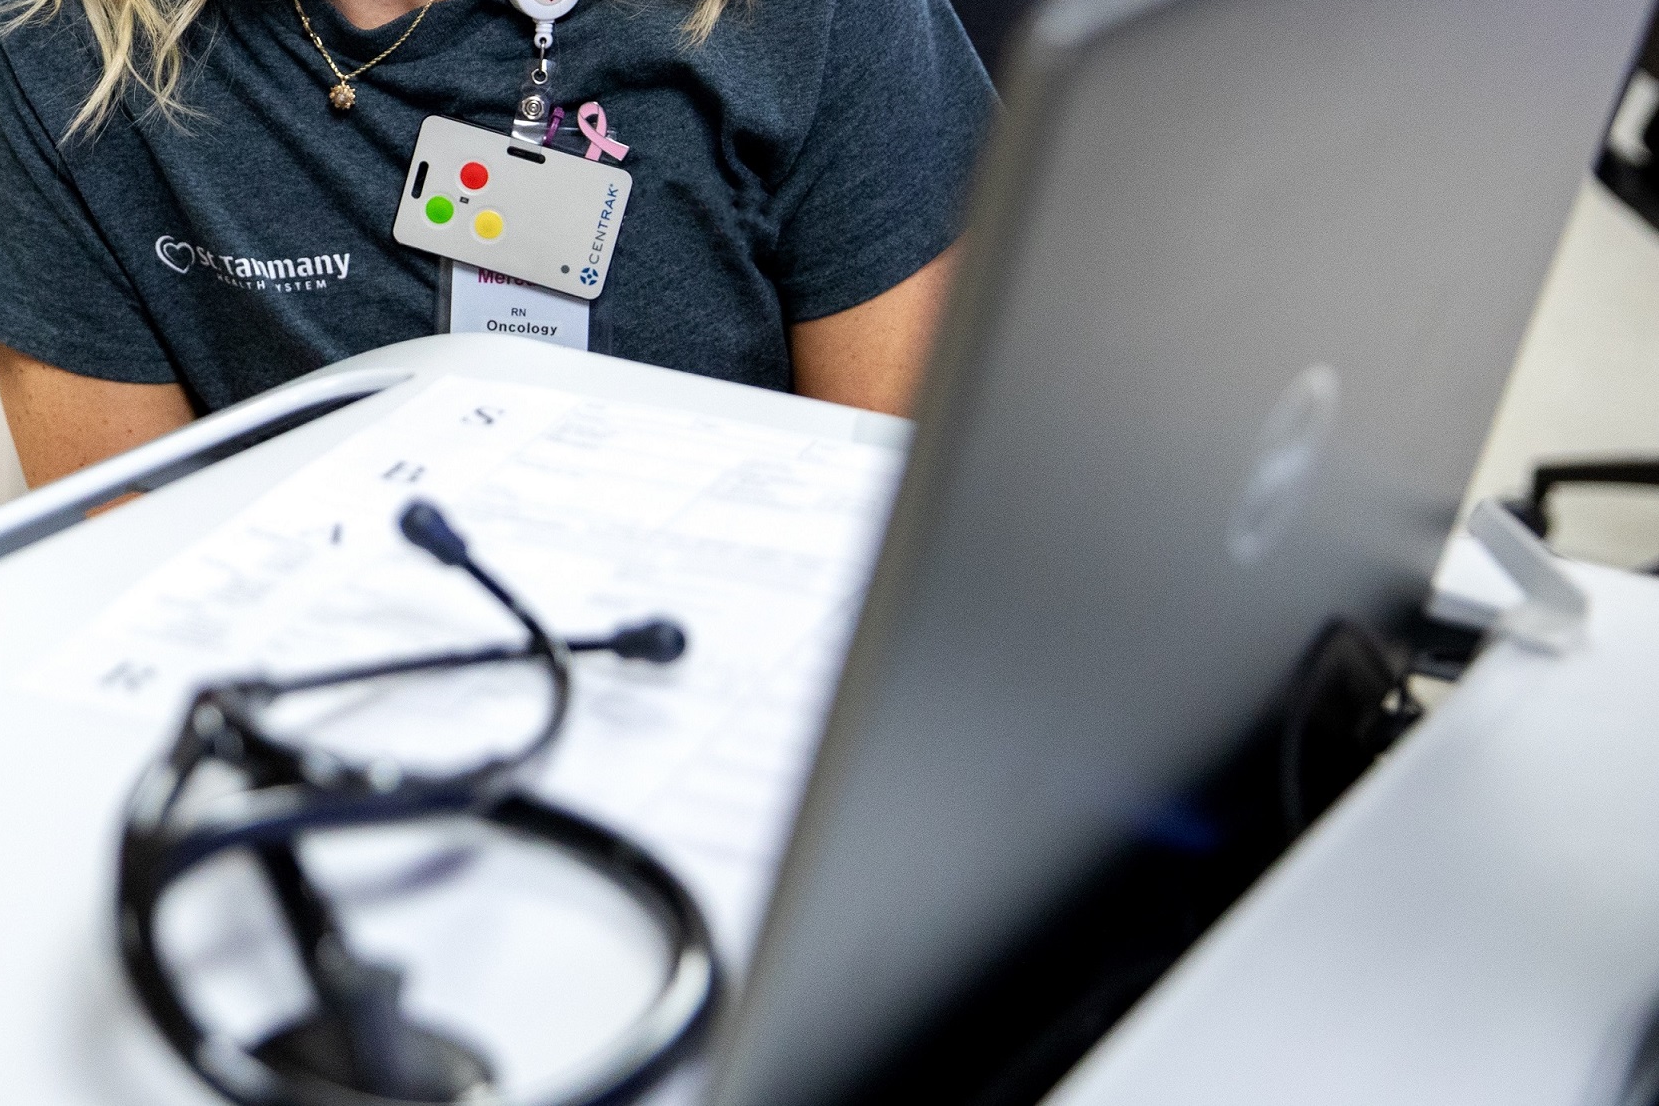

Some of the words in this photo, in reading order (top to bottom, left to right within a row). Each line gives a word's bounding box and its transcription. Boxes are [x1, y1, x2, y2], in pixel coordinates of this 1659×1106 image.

[588, 186, 620, 265] CENTRAK
[274, 279, 328, 292] YSTEM
[510, 307, 527, 317] RN
[486, 319, 558, 336] Oncology
